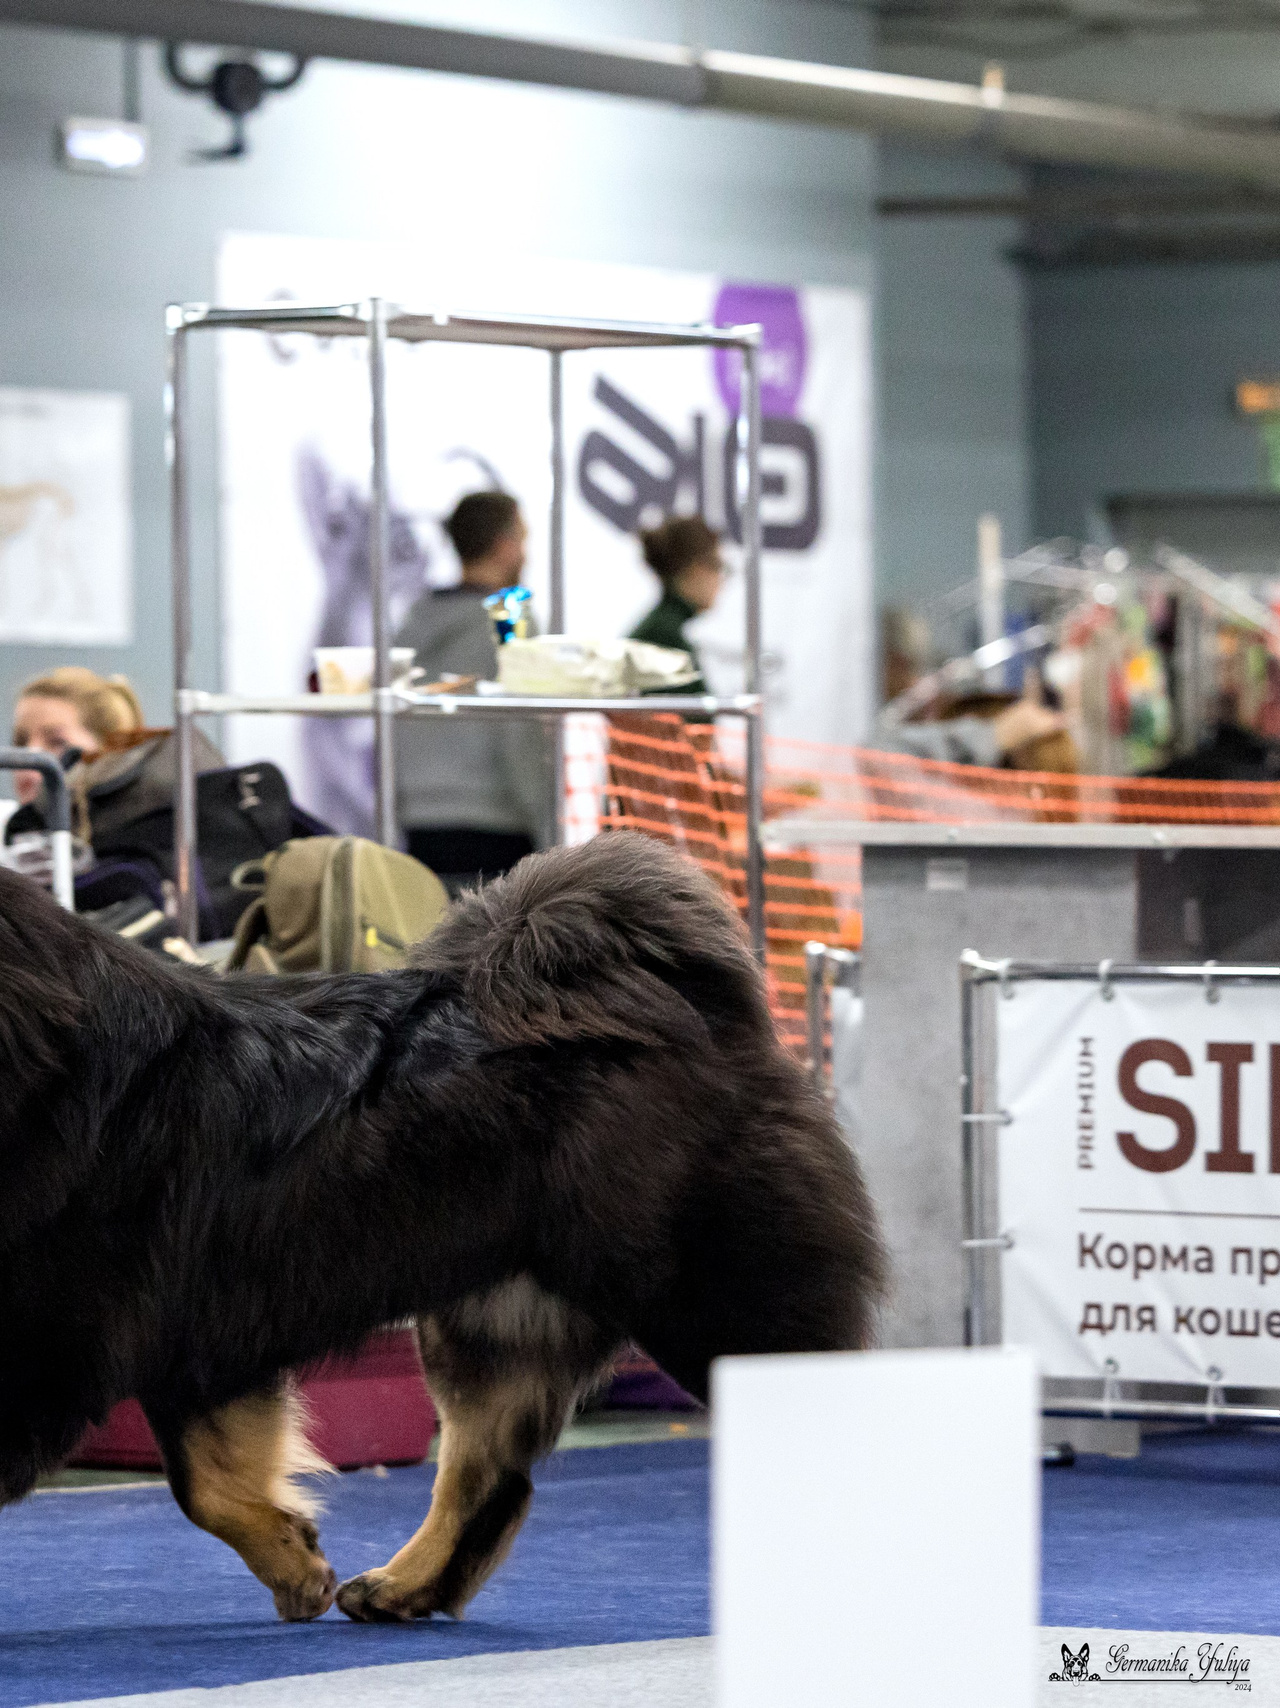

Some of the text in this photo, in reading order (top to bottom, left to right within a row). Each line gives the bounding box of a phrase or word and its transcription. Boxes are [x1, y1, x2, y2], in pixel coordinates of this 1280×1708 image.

[1077, 1036, 1095, 1170] PREMIUM
[1116, 1037, 1280, 1173] SI
[1078, 1232, 1280, 1285] Корма пр
[1079, 1302, 1280, 1337] для коше
